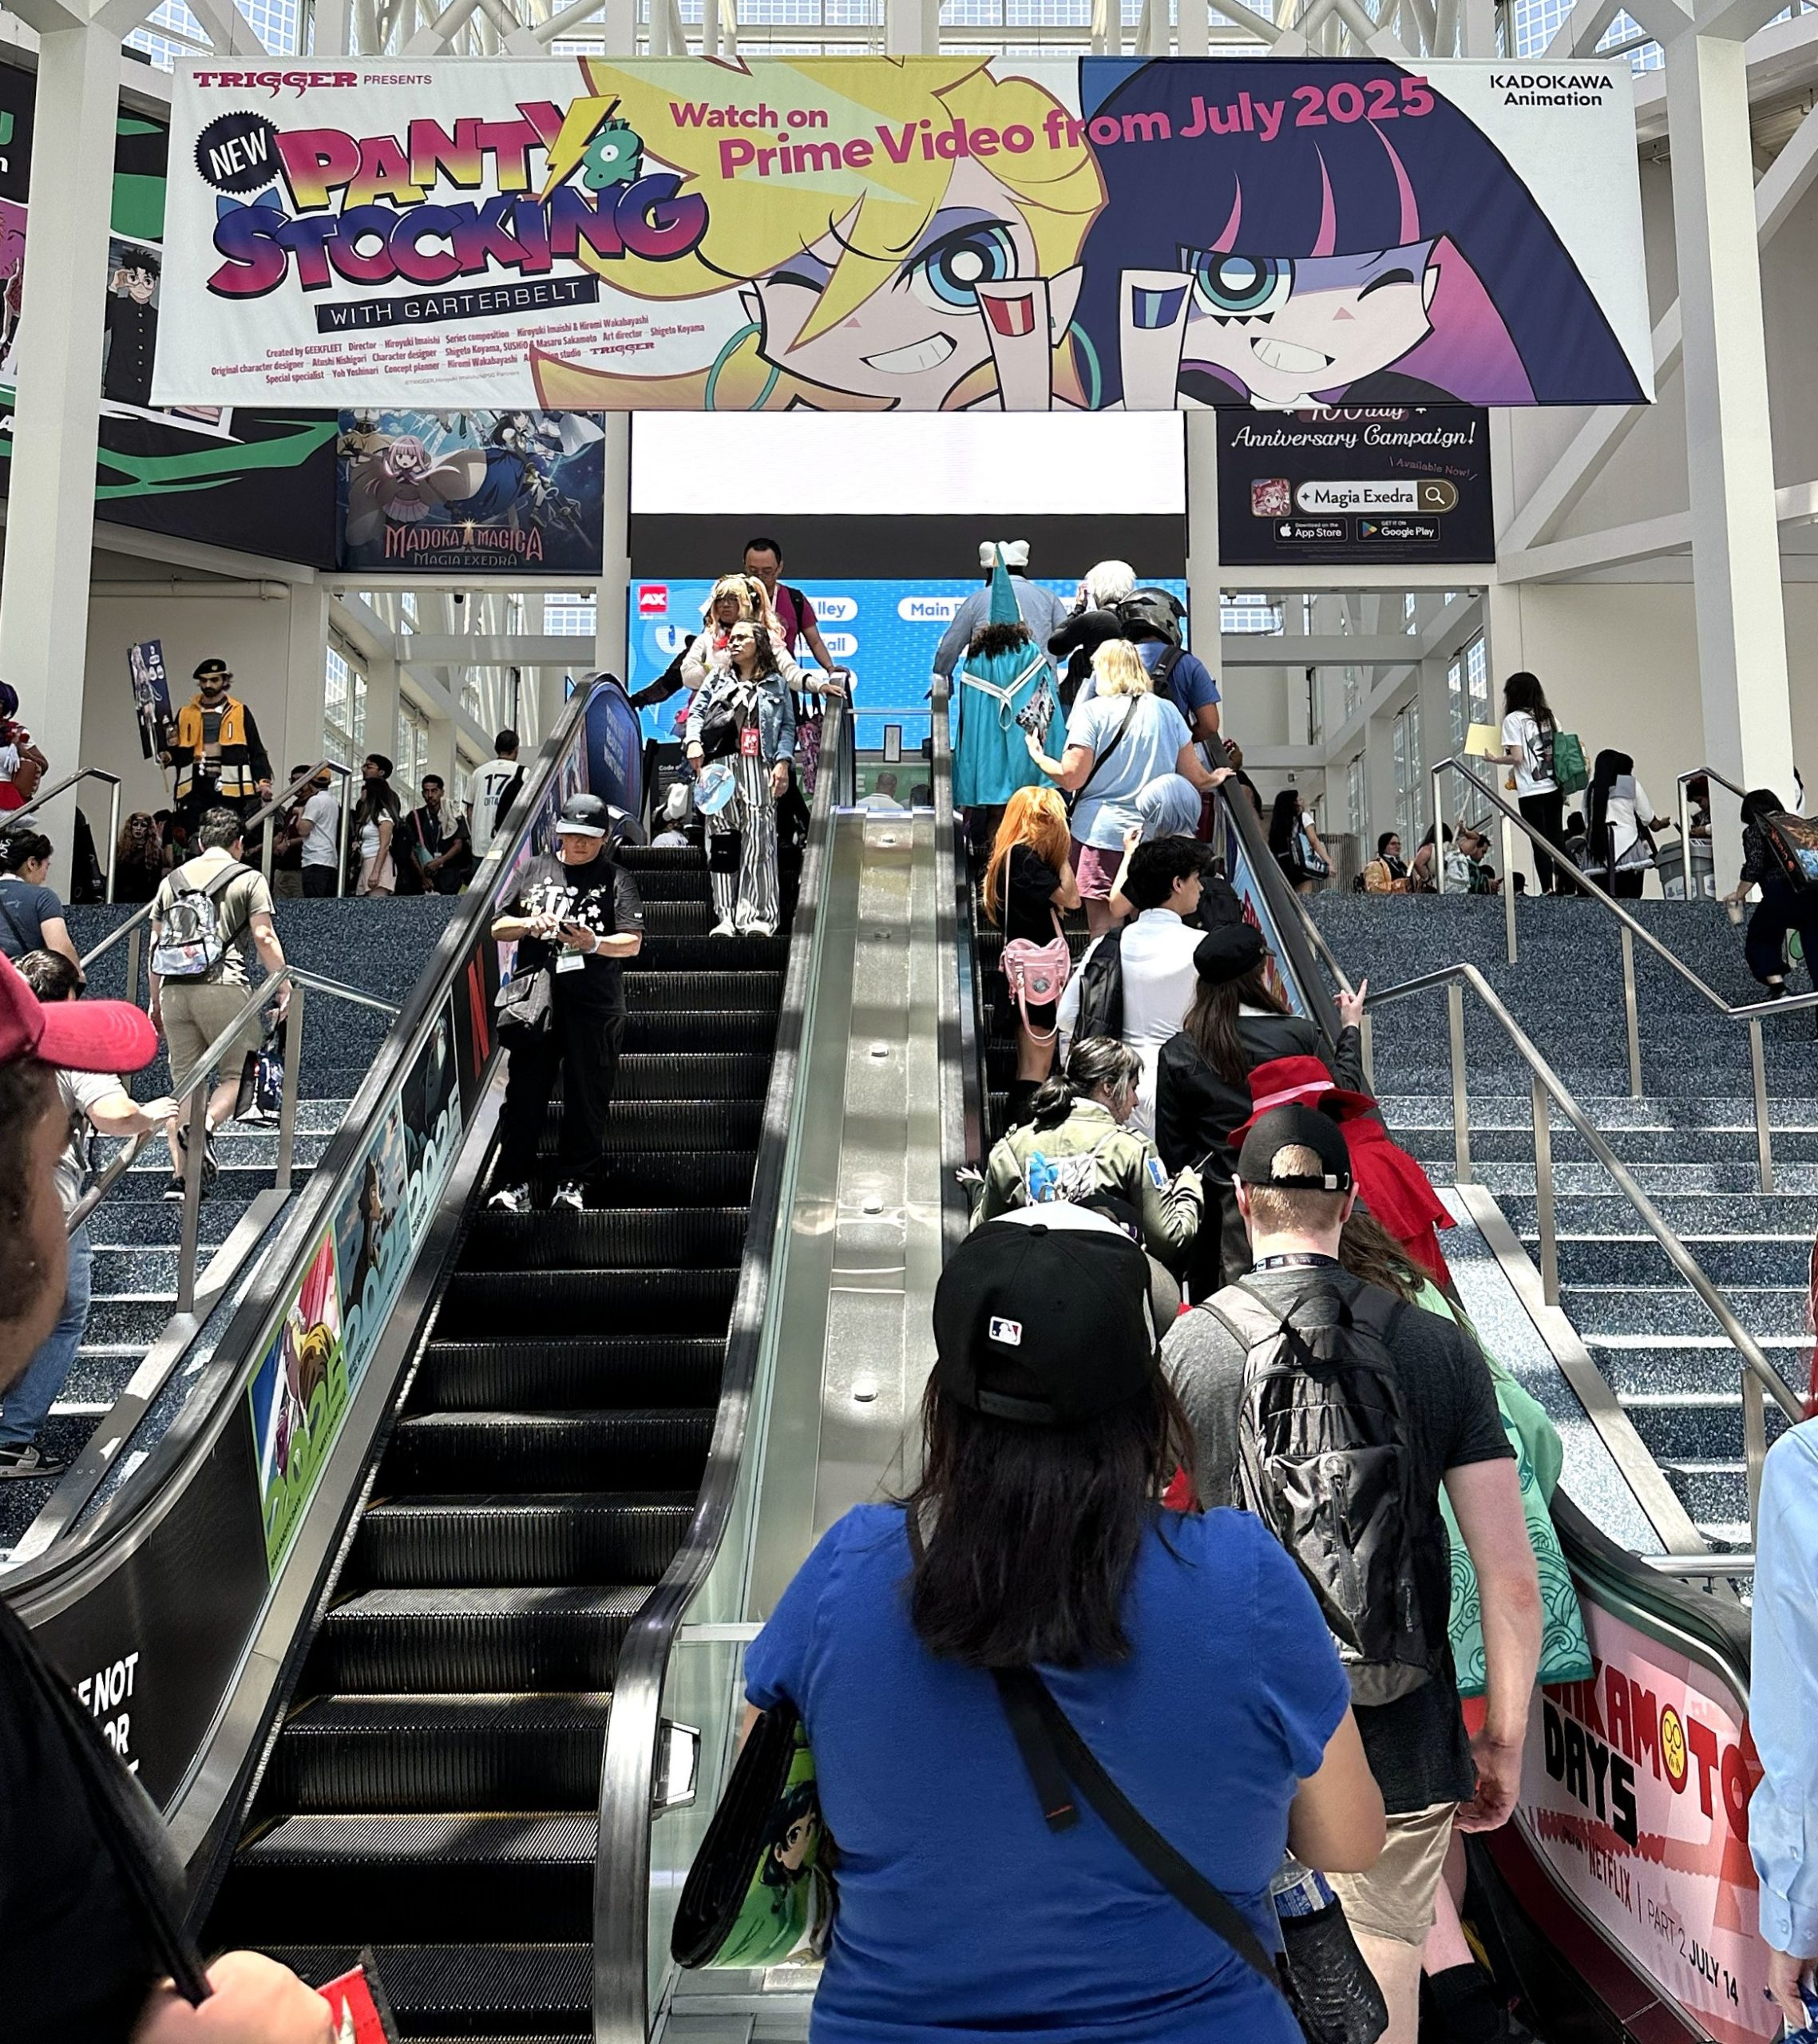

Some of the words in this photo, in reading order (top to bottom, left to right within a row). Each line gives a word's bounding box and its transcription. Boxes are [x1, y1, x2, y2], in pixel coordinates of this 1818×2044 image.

[193, 71, 358, 97] TRIGGER
[363, 73, 432, 85] PRESENTS
[1491, 74, 1614, 89] KADOKAWA
[1503, 90, 1603, 106] Animation
[669, 101, 778, 129] Watch
[786, 107, 828, 129] on
[719, 132, 873, 180] Prime
[875, 117, 1035, 164] Video
[1042, 109, 1171, 150] from
[1179, 92, 1285, 141] July
[1291, 76, 1436, 128] 2025
[209, 127, 269, 181] NEW
[273, 93, 620, 212] PANTY
[206, 172, 710, 300] STOCKING
[331, 303, 393, 327] WITH
[405, 279, 580, 320] GARTERBELT
[266, 348, 294, 358] Created
[295, 347, 303, 357] by
[305, 343, 343, 355] GEEKFLEET
[348, 341, 377, 351] Director
[385, 337, 414, 349] Hiroyuki
[414, 335, 440, 346] Imaishi
[446, 334, 466, 343] Series
[468, 331, 509, 343] composition
[517, 325, 546, 338] Hiroyuki
[547, 322, 572, 333] Imaishi
[572, 321, 578, 331] &
[580, 320, 602, 330] Hiromi
[604, 315, 649, 328] Wakabayashi
[211, 364, 239, 378] Original
[240, 362, 272, 372] character
[274, 358, 304, 371] designer
[372, 349, 406, 362] Character
[407, 347, 437, 360] designer
[445, 346, 471, 358] Shigeto
[472, 343, 502, 355] Koyama,
[536, 335, 562, 347] Masaru
[563, 335, 597, 345] Sakamoto
[603, 331, 615, 342] Art
[615, 329, 642, 340] director
[650, 326, 676, 338] Shigeto
[677, 323, 705, 335] Koyama
[266, 372, 291, 385] Special
[291, 370, 325, 383] specialist
[331, 369, 346, 378] Yoh
[346, 366, 378, 377] Yoshinari
[384, 363, 412, 375] Concept
[413, 362, 440, 374] planner
[447, 358, 471, 368] Hiromi
[472, 354, 517, 367] Wakabayashi
[560, 347, 582, 359] studio
[589, 342, 655, 357] TRIGGER
[1231, 426, 1360, 449] Anniversary
[1364, 422, 1476, 449] Campaign!
[1396, 458, 1443, 474] Available
[1444, 464, 1471, 477] Now!
[1314, 489, 1361, 508] Magia
[1364, 487, 1414, 504] Exedra
[384, 524, 459, 559] MADOKA
[477, 525, 544, 561] MAGICA
[1295, 529, 1315, 539] App
[1316, 528, 1342, 537] Store
[1381, 526, 1414, 538] Google
[1416, 526, 1435, 537] Play
[414, 553, 461, 565] MAGIA
[464, 553, 517, 566] EXEDRA
[640, 593, 667, 606] AX
[816, 600, 846, 618] lley
[911, 602, 950, 616] Main
[823, 637, 846, 651] all
[484, 773, 512, 796] 17
[93, 1652, 139, 1717] NOT
[1542, 1654, 1751, 1843] KAMOTO
[1543, 1698, 1638, 1848] DAYS
[1588, 1836, 1631, 1914] NETFLIX
[1647, 1899, 1676, 1943] PART
[1677, 1927, 1687, 1959] 2
[1689, 1939, 1719, 1988] JULY
[1723, 1970, 1739, 2007] 14
